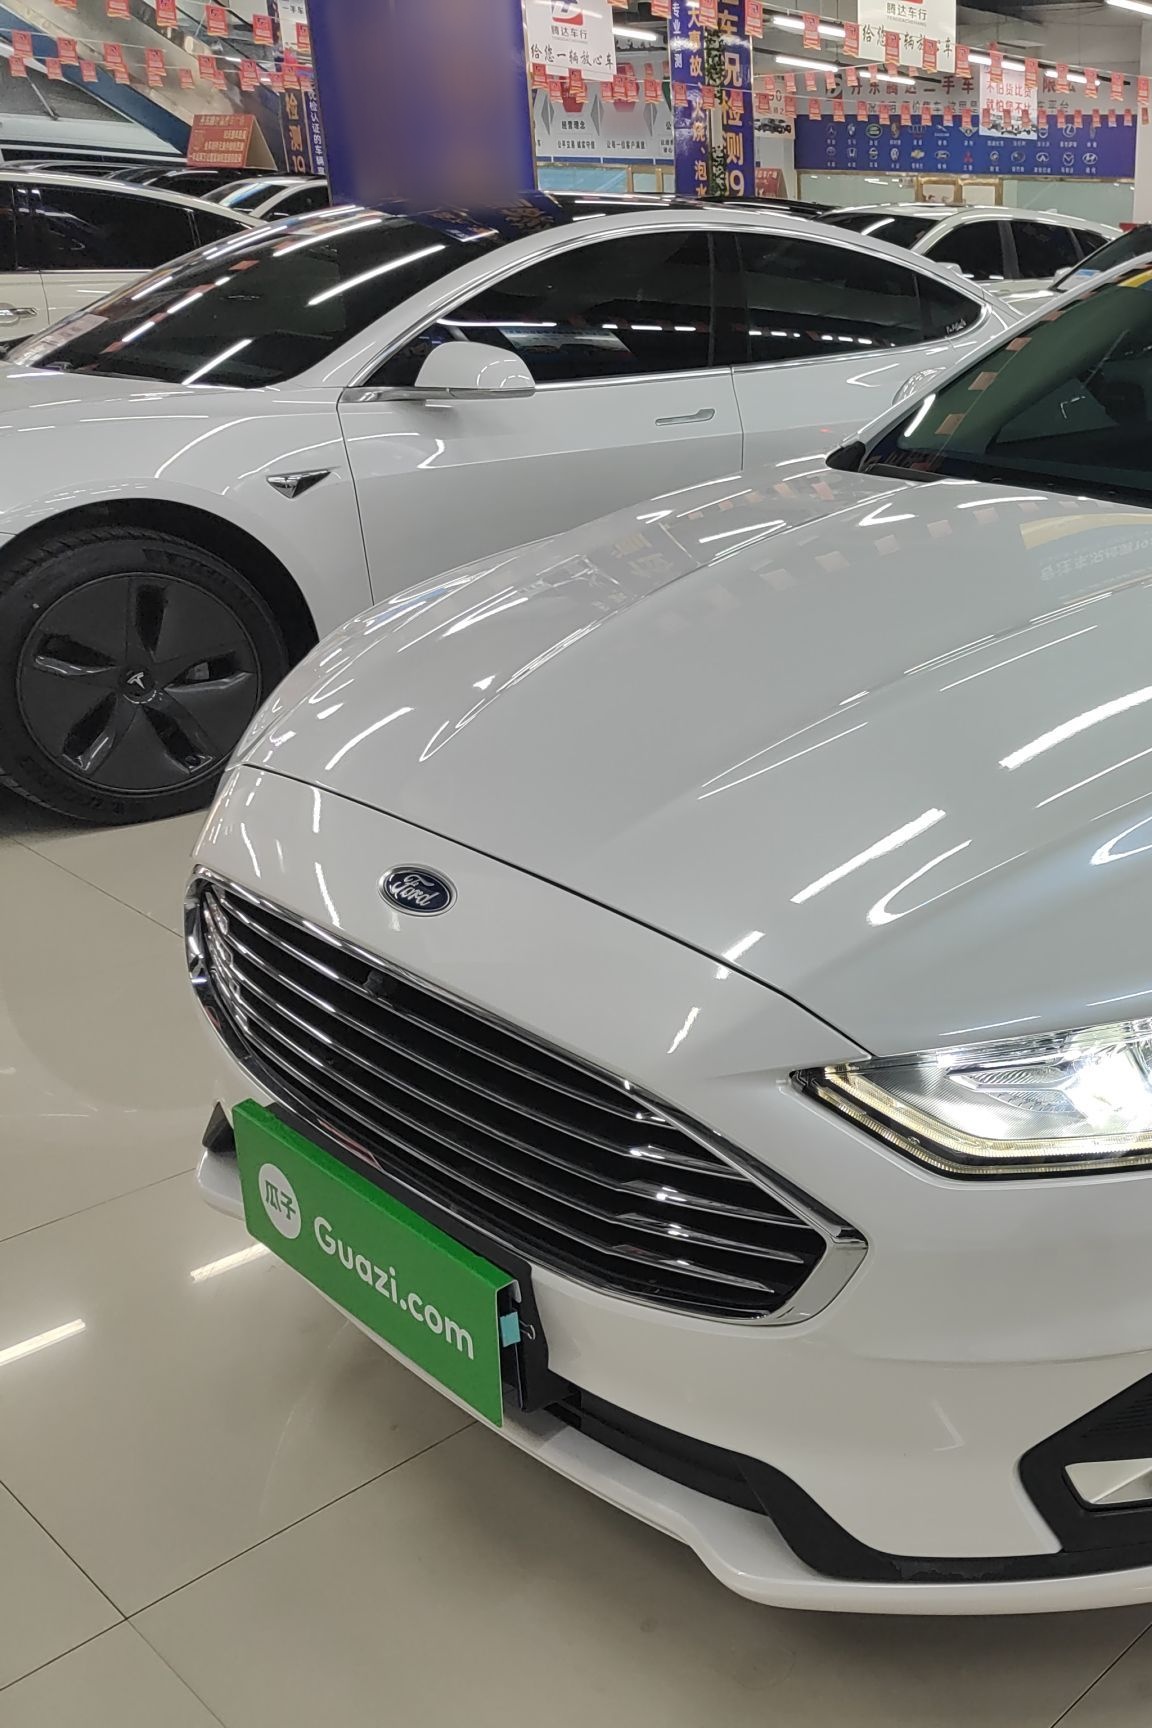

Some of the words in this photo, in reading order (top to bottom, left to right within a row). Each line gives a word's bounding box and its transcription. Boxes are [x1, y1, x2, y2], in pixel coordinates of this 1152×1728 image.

[886, 2, 927, 20] 腾达车行
[551, 26, 588, 40] 腾达车行
[531, 44, 615, 70] 给您一辆放心车
[391, 874, 440, 906] Ford
[265, 1180, 296, 1221] 瓜子
[313, 1215, 474, 1360] Guazi.com
